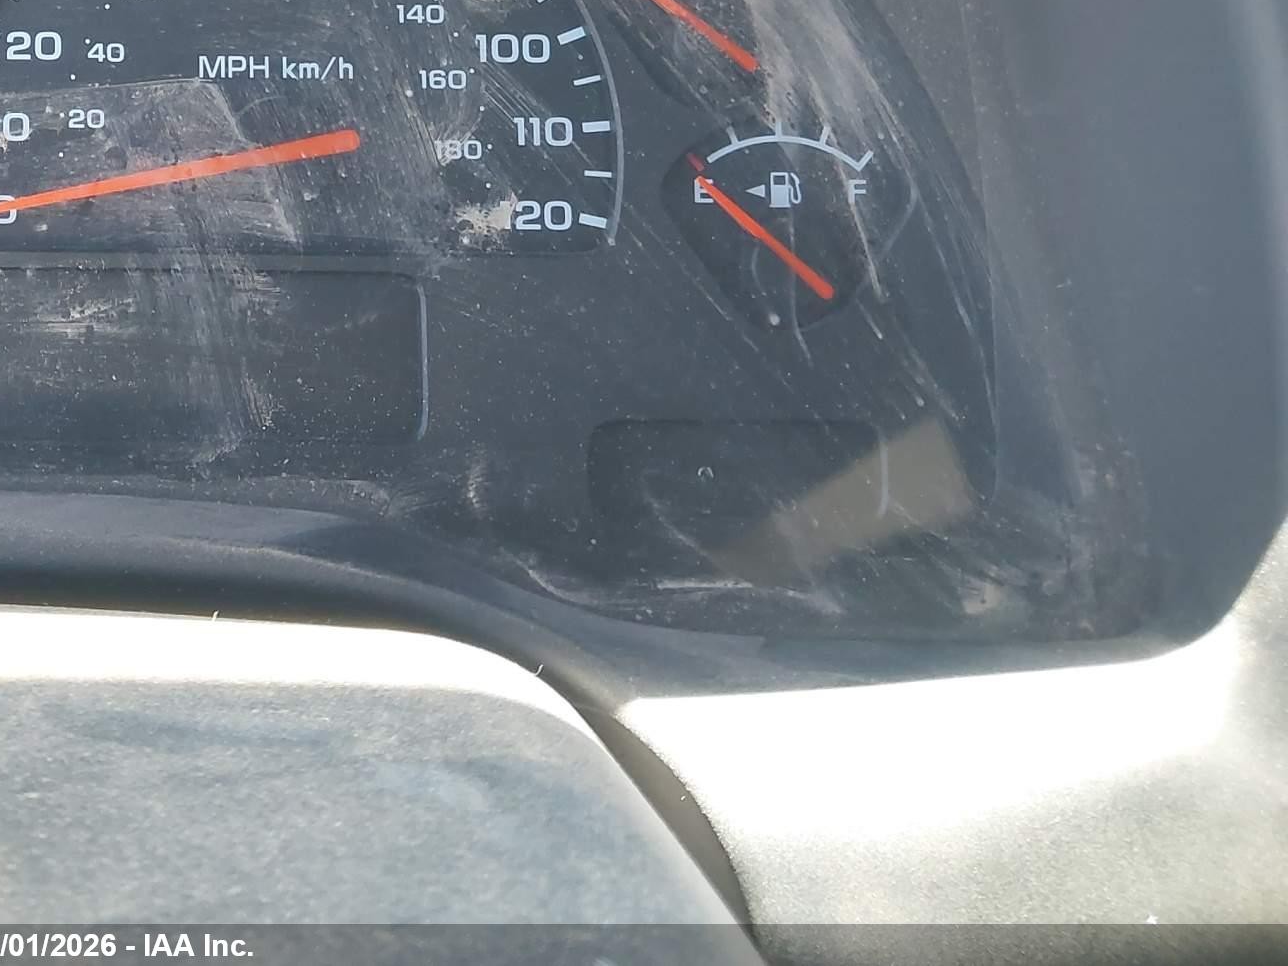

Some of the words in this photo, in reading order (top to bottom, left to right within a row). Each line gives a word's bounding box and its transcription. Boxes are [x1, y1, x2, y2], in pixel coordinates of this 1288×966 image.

[397, 4, 445, 25] 140
[6, 32, 62, 60] 20
[87, 42, 125, 63] 40
[476, 34, 550, 64] 100
[198, 56, 270, 79] MPH
[282, 56, 354, 81] km/h
[419, 69, 466, 90] 160
[68, 109, 105, 128] 20
[514, 117, 573, 146] 110
[849, 179, 866, 203] F
